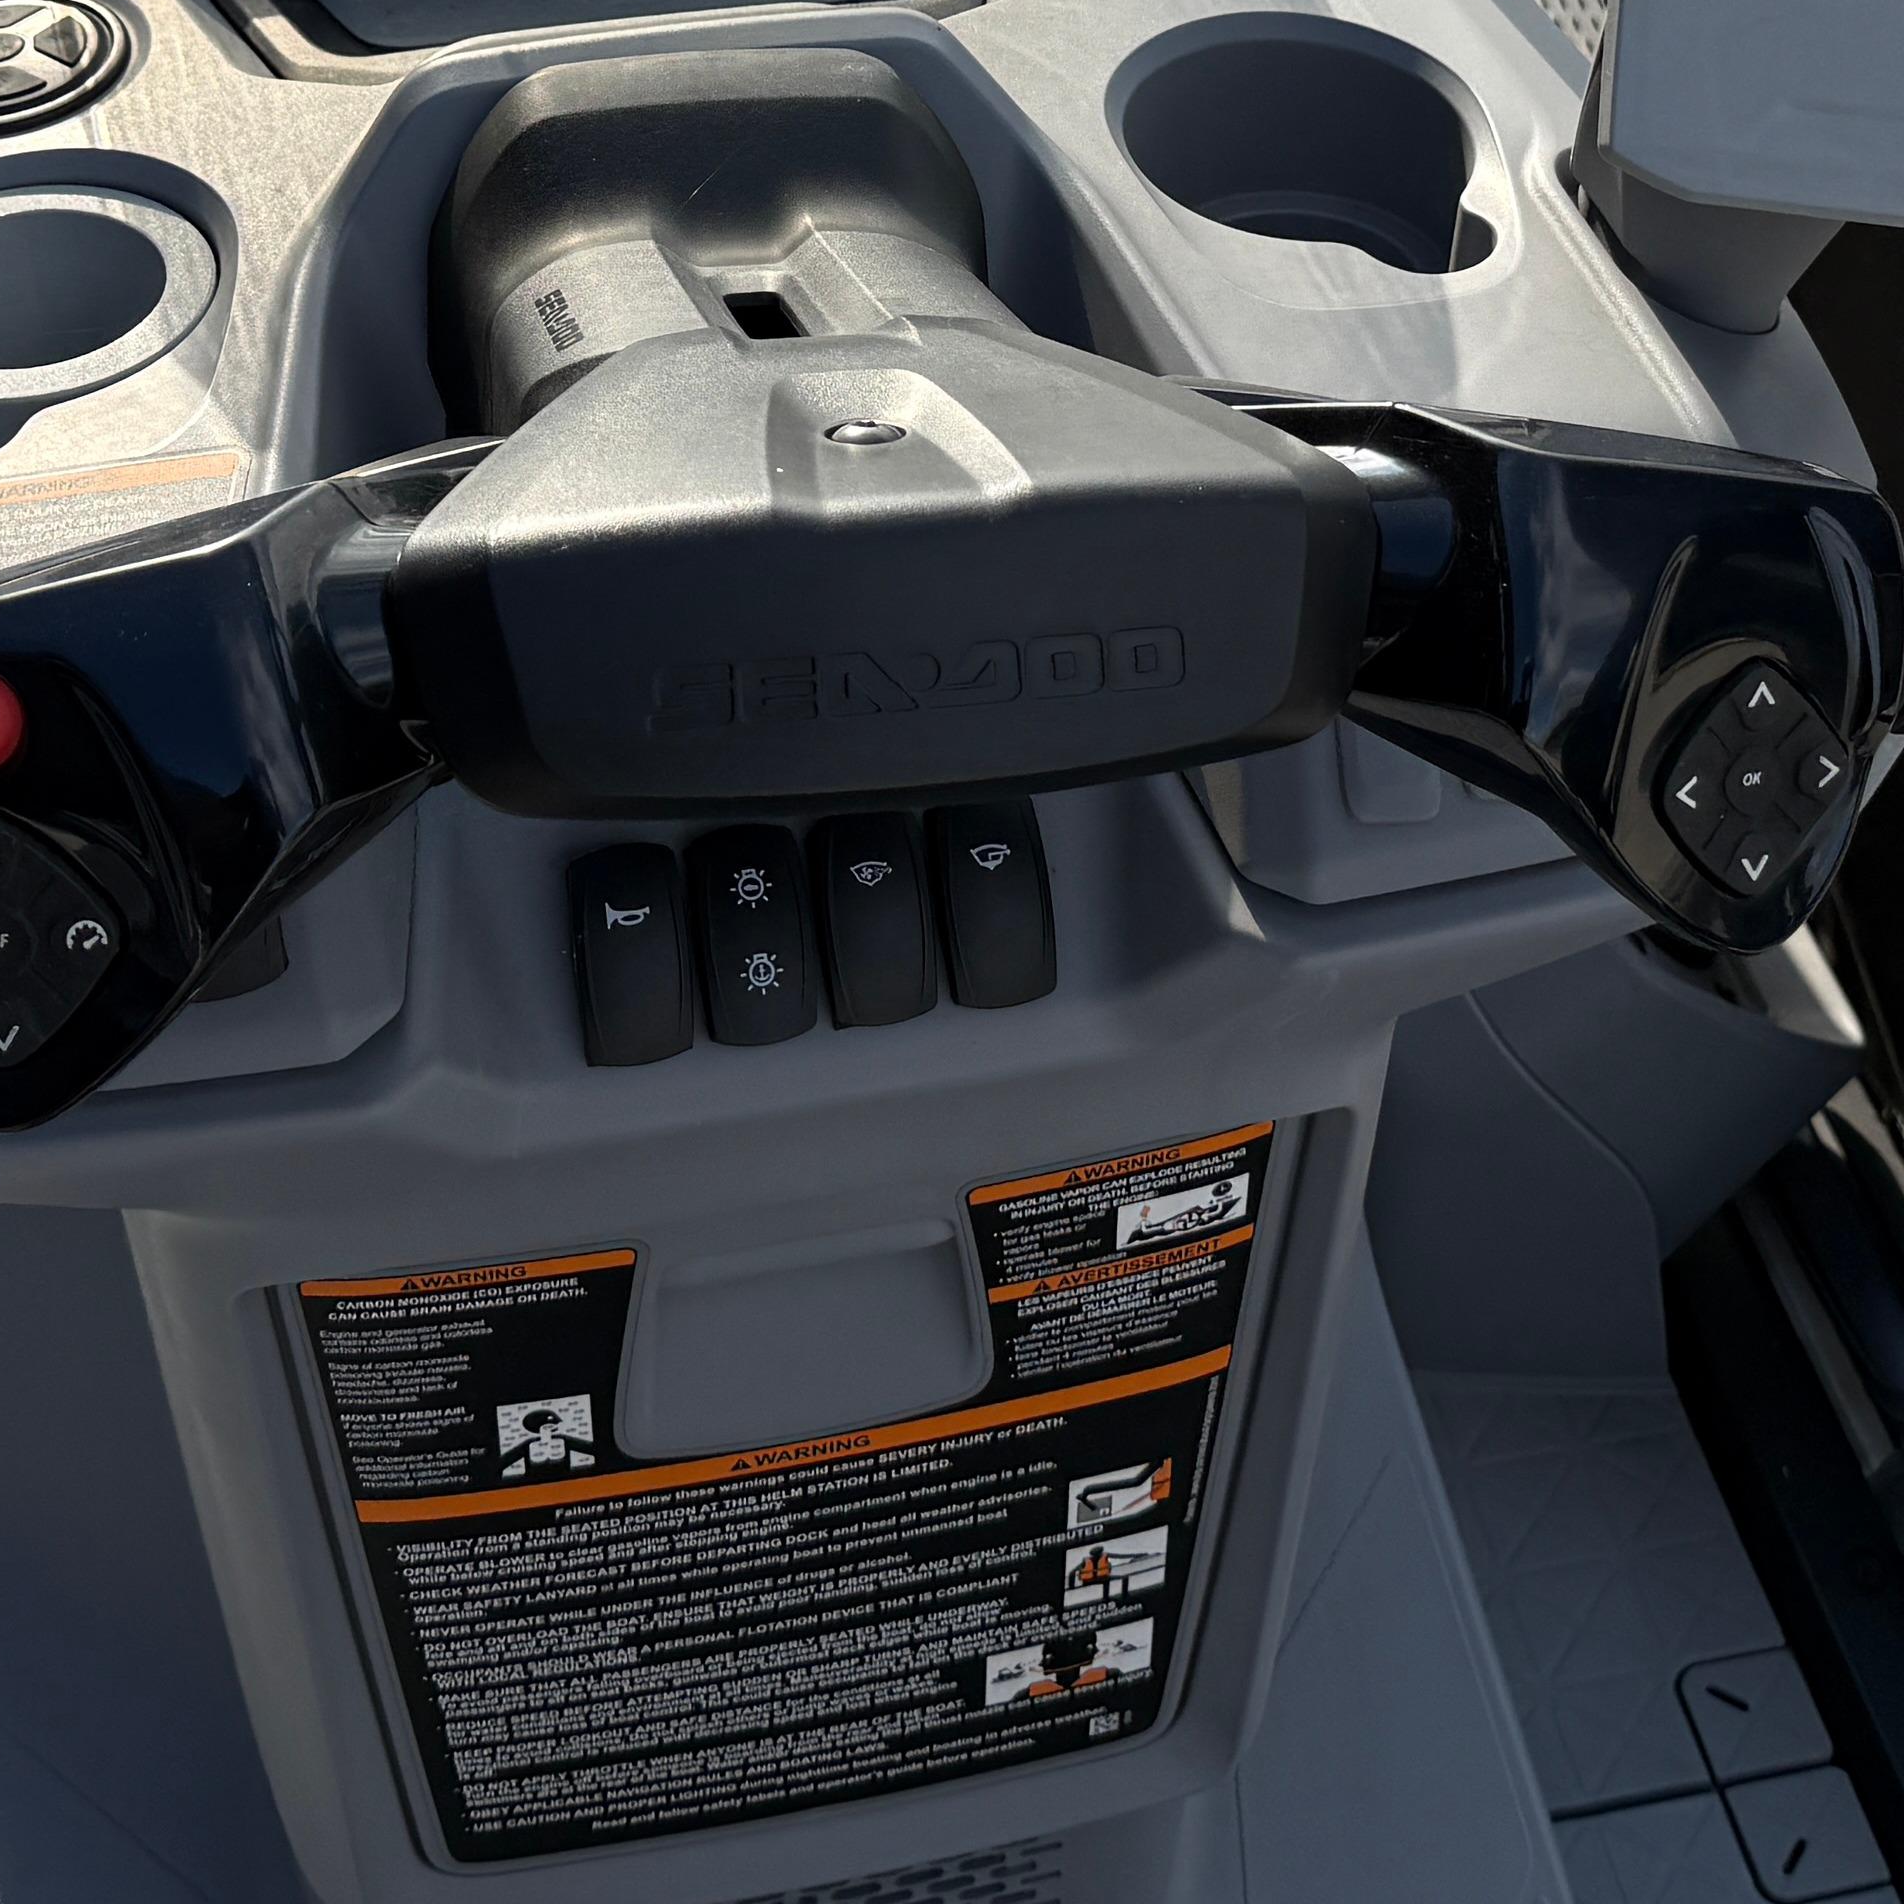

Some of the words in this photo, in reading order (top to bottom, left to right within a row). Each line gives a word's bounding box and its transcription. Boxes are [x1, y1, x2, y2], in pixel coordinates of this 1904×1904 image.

[1742, 771, 1762, 787] OK
[1084, 1145, 1180, 1181] WARNING
[419, 1265, 526, 1289] WARNING
[1057, 1237, 1221, 1288] AVERTISSEMENT
[554, 1502, 605, 1519] Failure
[608, 1499, 624, 1511] to
[627, 1491, 672, 1508] follow
[675, 1484, 714, 1500] these
[718, 1472, 785, 1493] warnings
[788, 1464, 828, 1481] could
[832, 1455, 873, 1473] cause
[878, 1442, 937, 1464] SEVERY
[941, 1431, 993, 1452] INJURY
[997, 1427, 1011, 1440] or
[1015, 1415, 1068, 1436] DEATH.
[755, 1434, 870, 1466] WARNING
[395, 1537, 473, 1554] VISIBILITY
[475, 1530, 522, 1545] FROM
[525, 1526, 556, 1539] THE
[560, 1517, 621, 1535] SEATED
[624, 1505, 696, 1525] POSITION
[699, 1501, 718, 1513] AT
[722, 1495, 757, 1510] THIS
[760, 1486, 802, 1503] HELM
[806, 1473, 869, 1494] STATION
[873, 1470, 886, 1482] IS
[891, 1456, 953, 1479] LIMITED.
[402, 1560, 475, 1578] OPERATE
[477, 1551, 545, 1570] BLOWER
[548, 1549, 564, 1560] to
[567, 1545, 604, 1557] clear
[607, 1534, 669, 1553] gasoline
[671, 1526, 721, 1543] vapors
[725, 1519, 758, 1534] from
[762, 1509, 809, 1528] engine
[813, 1491, 905, 1519] compartment
[909, 1482, 946, 1498] when
[950, 1471, 997, 1491] engine
[1001, 1468, 1012, 1479] is
[1016, 1465, 1025, 1476] a
[1028, 1459, 1057, 1474] idle.
[408, 1585, 463, 1600] CHECK
[464, 1576, 541, 1594] WEATHER
[544, 1563, 627, 1585] FORECAST
[630, 1553, 693, 1571] BEFORE
[696, 1537, 782, 1561] DEPARTING
[785, 1528, 828, 1545] DOCK
[832, 1522, 858, 1536] and
[862, 1515, 896, 1530] heed
[899, 1511, 916, 1523] all
[920, 1499, 974, 1519] weather
[978, 1483, 1052, 1507] advisories.
[412, 1601, 459, 1616] WEAR
[461, 1595, 523, 1610] SAFETY
[525, 1585, 597, 1603] LANYARD
[600, 1582, 613, 1592] at
[616, 1579, 635, 1589] all
[638, 1572, 677, 1586] times
[680, 1565, 718, 1579] while
[721, 1552, 789, 1572] operating
[793, 1545, 823, 1560] boat
[827, 1542, 841, 1553] to
[845, 1531, 898, 1550] prevent
[901, 1515, 973, 1539] unmanned
[977, 1508, 1008, 1523] boat
[418, 1623, 471, 1638] NEVER
[473, 1614, 546, 1632] OPERATE
[548, 1607, 598, 1623] WHILE
[600, 1598, 653, 1615] UNDER
[656, 1592, 687, 1606] THE
[689, 1577, 773, 1601] INFLUENCE
[777, 1574, 791, 1585] of
[795, 1566, 835, 1582] drugs
[839, 1562, 854, 1573] or
[857, 1550, 912, 1570] alcohol.
[422, 1642, 447, 1653] DO
[449, 1638, 482, 1650] NOT
[484, 1626, 569, 1646] OVERLOAD
[572, 1621, 602, 1634] THE
[605, 1614, 649, 1629] BOAT.
[652, 1603, 713, 1621] ENSURE
[717, 1595, 756, 1610] THAT
[759, 1584, 817, 1602] WEIGHT
[821, 1581, 834, 1591] IS
[838, 1565, 915, 1588] PROPERLY
[918, 1558, 949, 1572] AND
[952, 1545, 1007, 1565] EVENLY
[1011, 1524, 1103, 1553] DISTRIBUTED
[437, 1690, 481, 1704] MAKE
[483, 1685, 525, 1698] SURE
[527, 1679, 567, 1692] THAT
[569, 1674, 599, 1686] ALL
[602, 1657, 701, 1681] PASSENGERS
[704, 1651, 735, 1664] ARE
[737, 1636, 815, 1658] PROPERLY
[818, 1624, 875, 1643] SEATED
[878, 1614, 924, 1632] WHILE
[927, 1597, 1008, 1622] UNDERWAY.
[526, 1653, 589, 1670] SHOULD
[592, 1645, 638, 1661] WEAR
[639, 1643, 651, 1653] A
[654, 1628, 734, 1651] PERSONAL
[737, 1613, 818, 1636] FLOTATION
[821, 1602, 874, 1621] DEVICE
[878, 1594, 914, 1610] THAT
[918, 1590, 932, 1602] IS
[936, 1572, 1019, 1598] COMPLIANT
